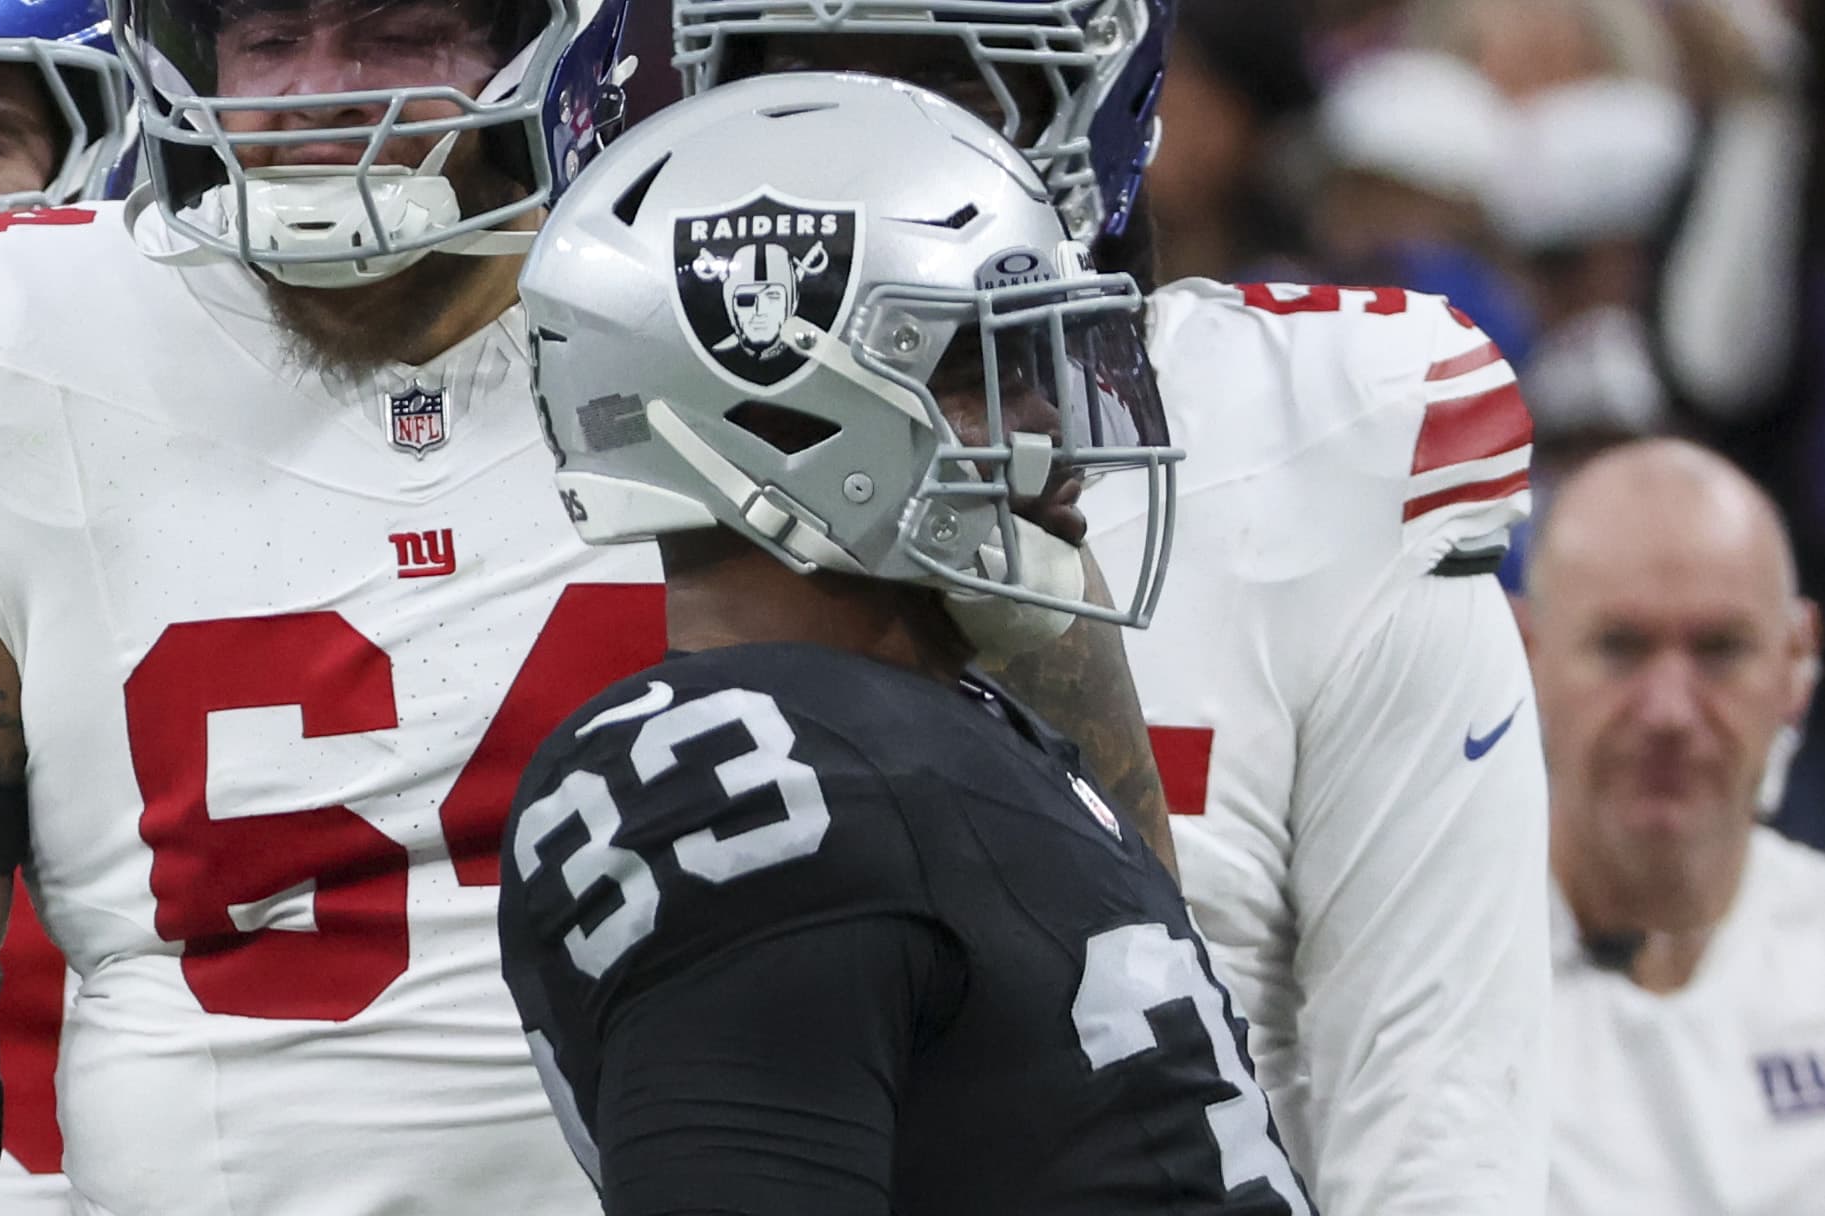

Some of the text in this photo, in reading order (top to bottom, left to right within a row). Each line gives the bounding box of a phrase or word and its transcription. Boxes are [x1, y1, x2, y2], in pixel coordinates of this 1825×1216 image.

[690, 213, 838, 242] RAIDERS
[397, 414, 440, 444] NFL
[388, 527, 457, 579] ny
[513, 687, 832, 981] 33
